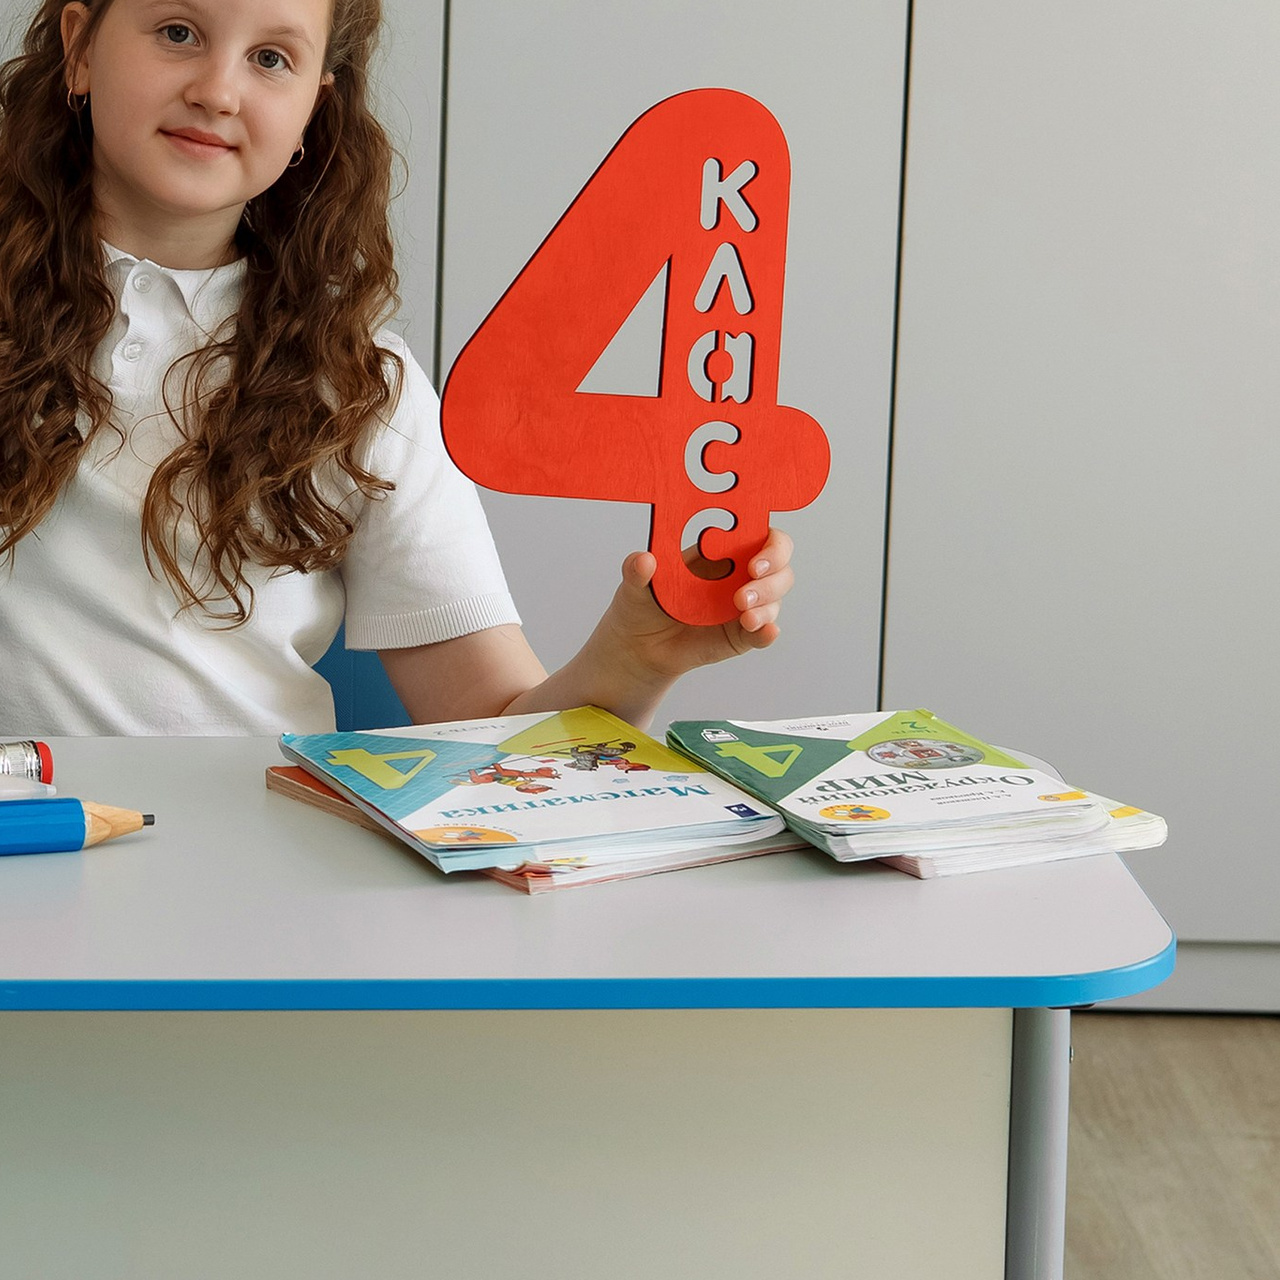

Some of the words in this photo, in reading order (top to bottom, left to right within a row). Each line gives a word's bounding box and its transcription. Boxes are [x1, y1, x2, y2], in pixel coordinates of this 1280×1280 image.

[325, 749, 438, 790] 4
[715, 740, 803, 778] 4
[437, 783, 713, 822] Математика
[795, 773, 1035, 807] Окружающий
